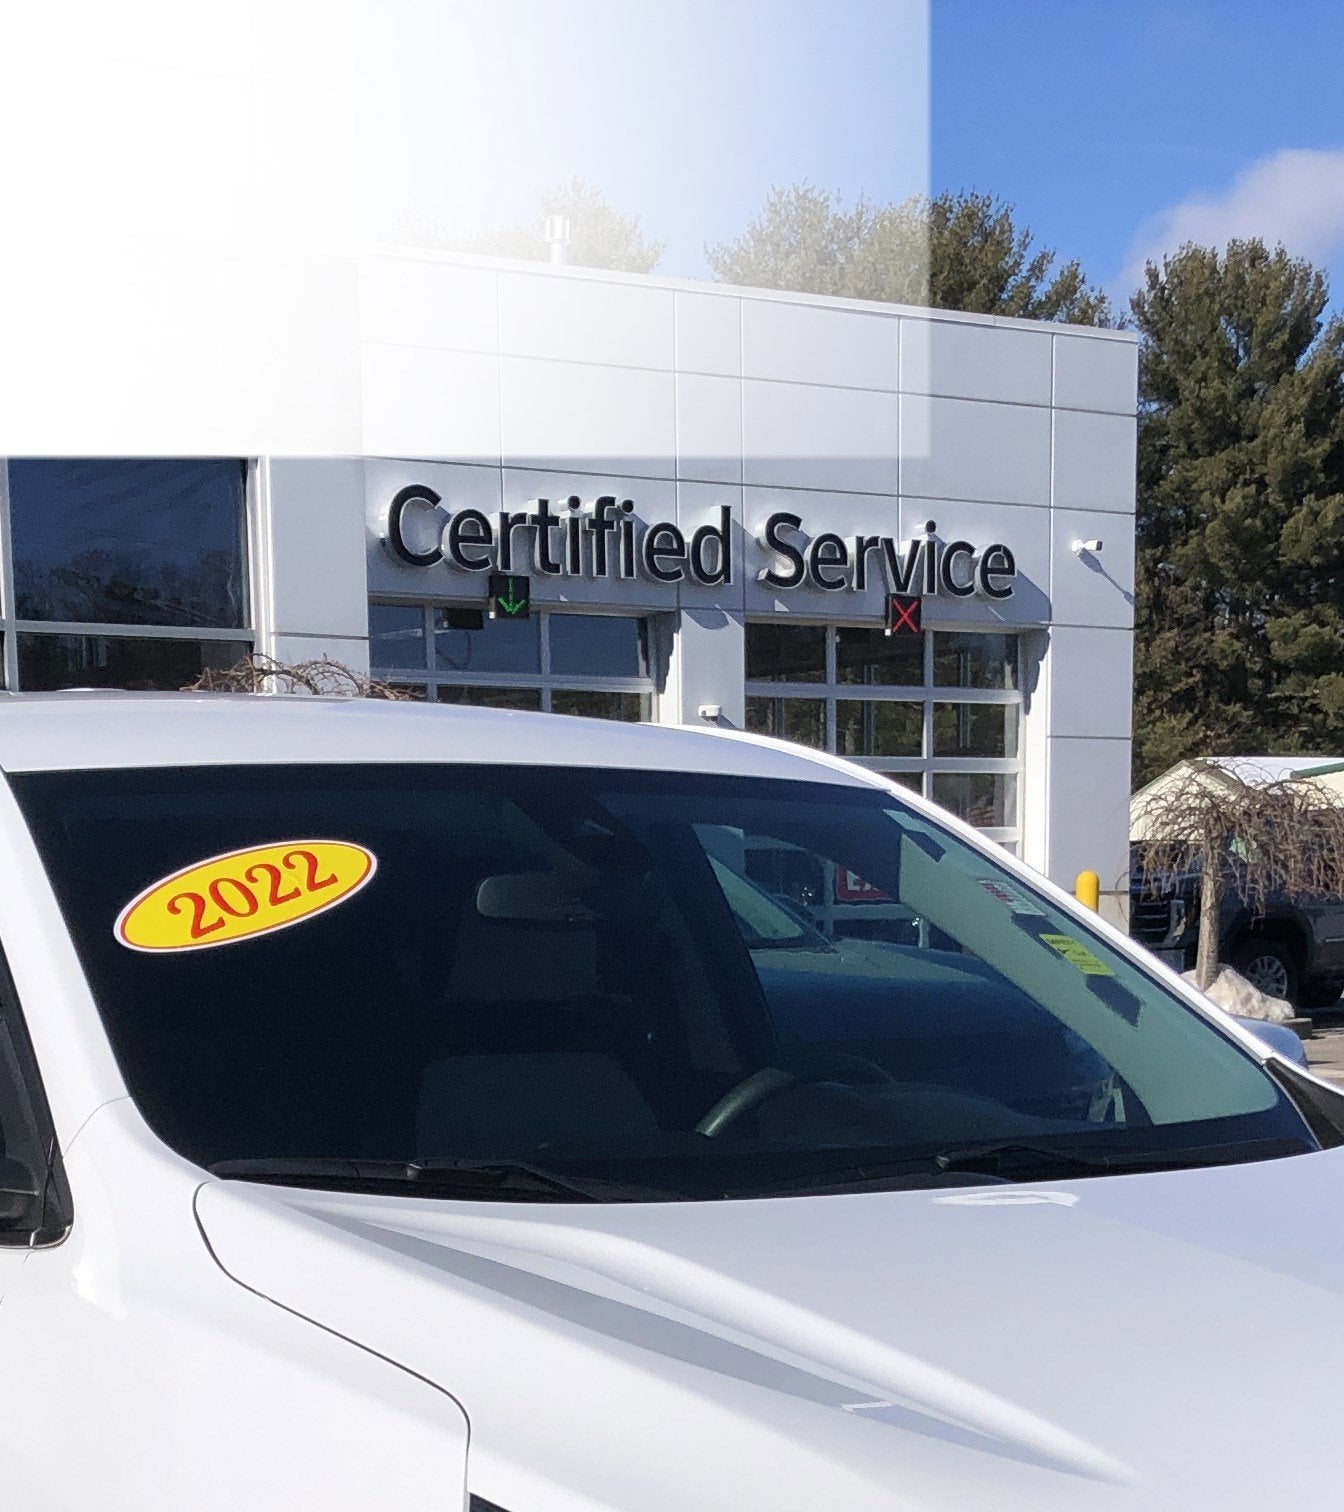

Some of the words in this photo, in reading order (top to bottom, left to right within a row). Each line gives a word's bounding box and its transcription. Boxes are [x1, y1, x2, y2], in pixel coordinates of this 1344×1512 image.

[386, 483, 733, 587] Certified
[761, 511, 1017, 600] Service
[166, 849, 339, 940] 2022
